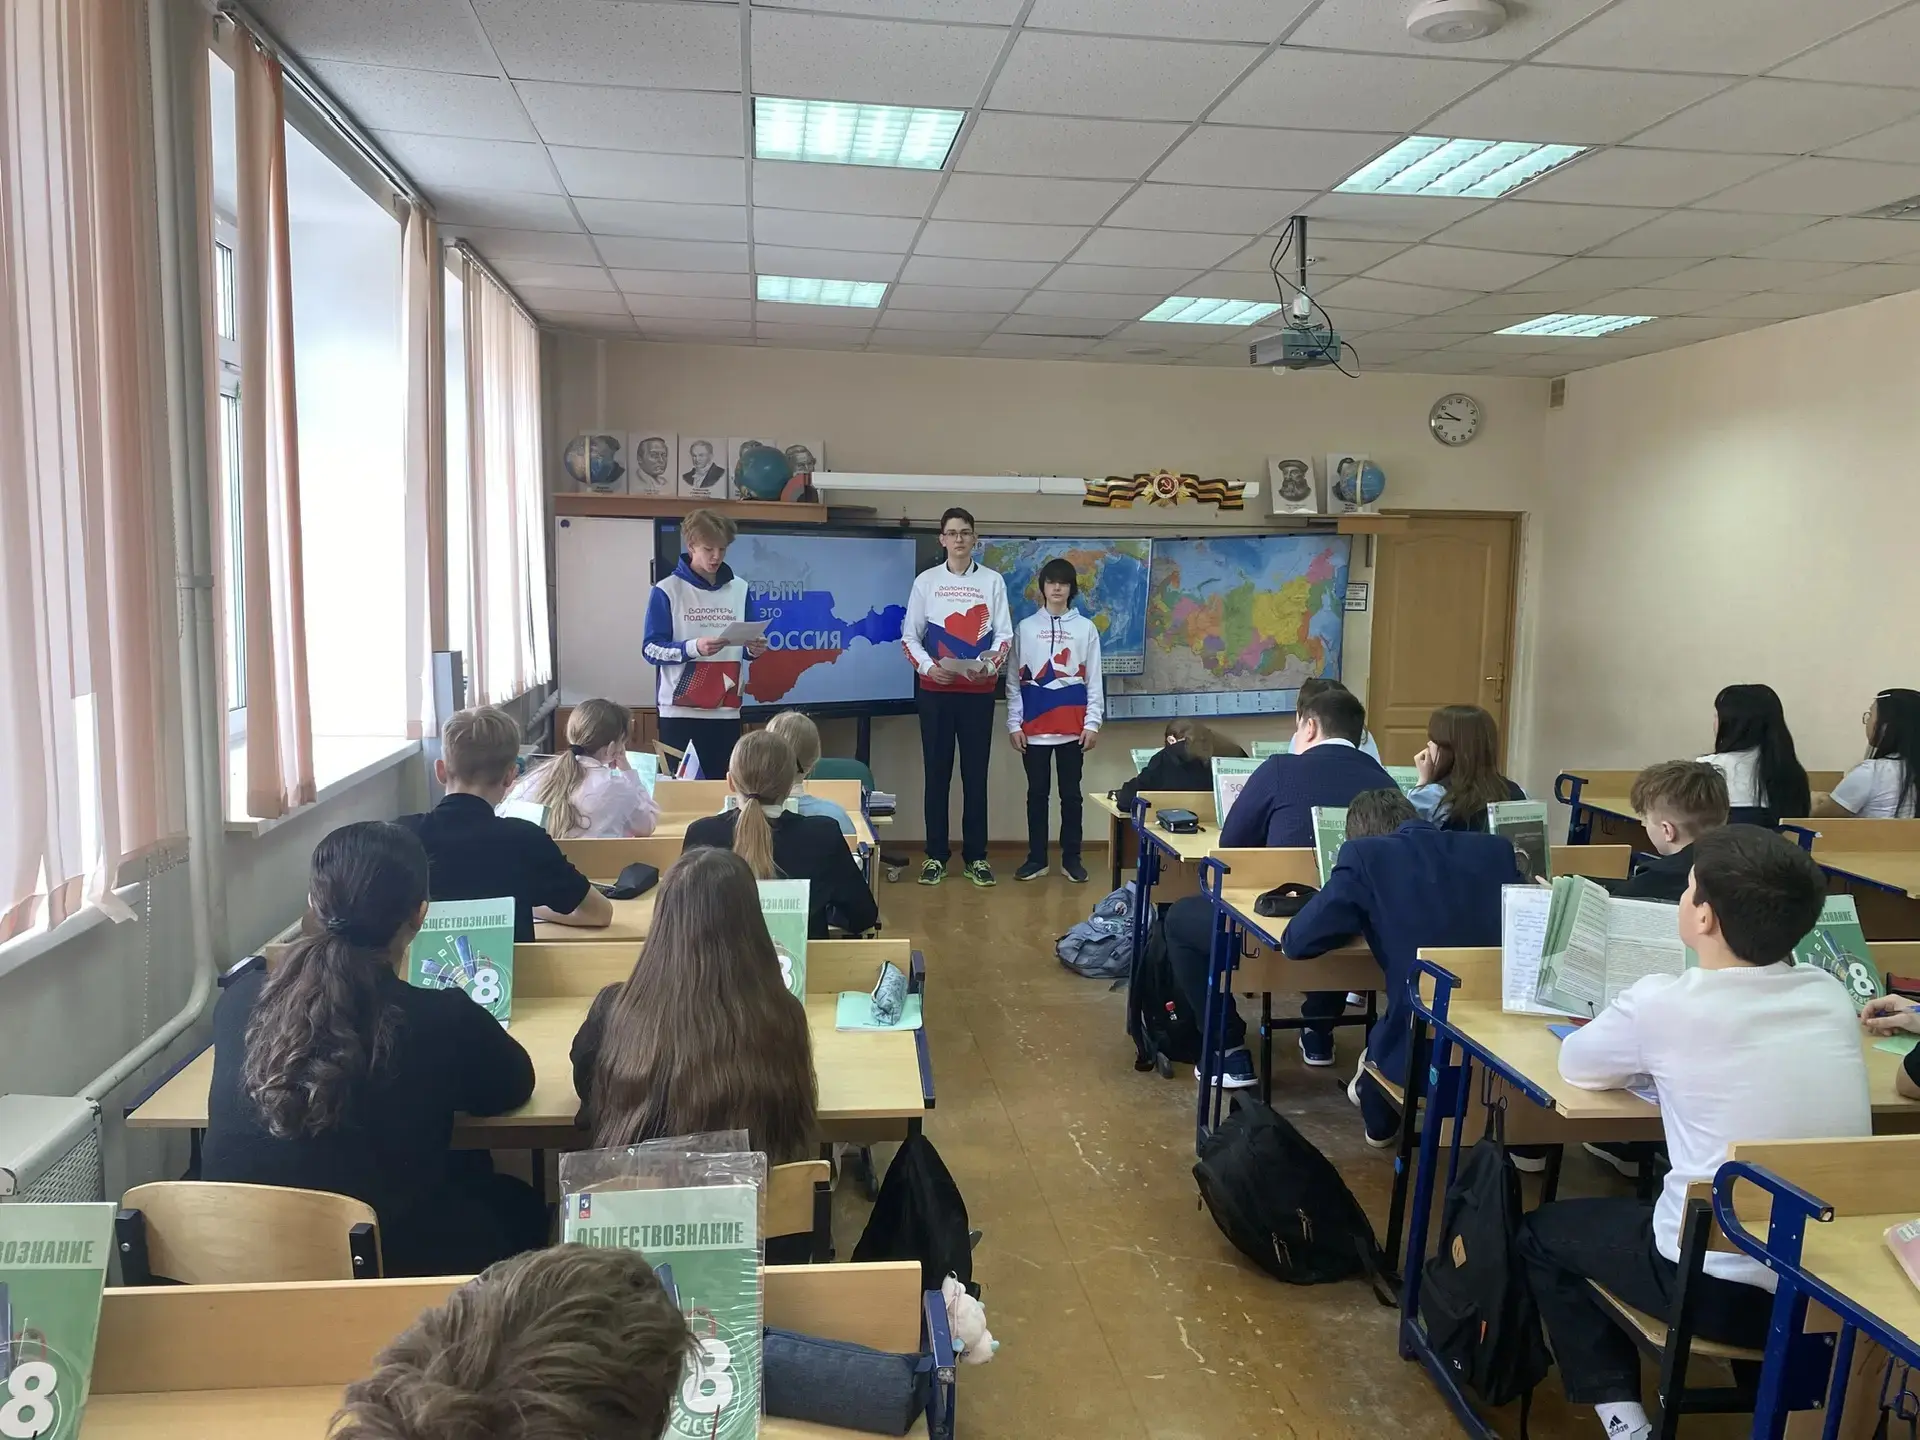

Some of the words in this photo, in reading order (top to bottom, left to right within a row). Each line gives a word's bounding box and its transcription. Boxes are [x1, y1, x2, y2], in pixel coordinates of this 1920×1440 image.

[688, 607, 733, 615] ВОЛОНТЕРЫ
[766, 630, 841, 651] ОССИЯ
[422, 914, 508, 930] БЩЕСТВОЗНАНИЕ
[472, 968, 500, 1004] 8
[1849, 963, 1875, 996] 8
[577, 1221, 744, 1248] ОБЩЕСТВОЗНАНИЕ
[682, 1338, 734, 1413] 8
[0, 1361, 58, 1438] 8
